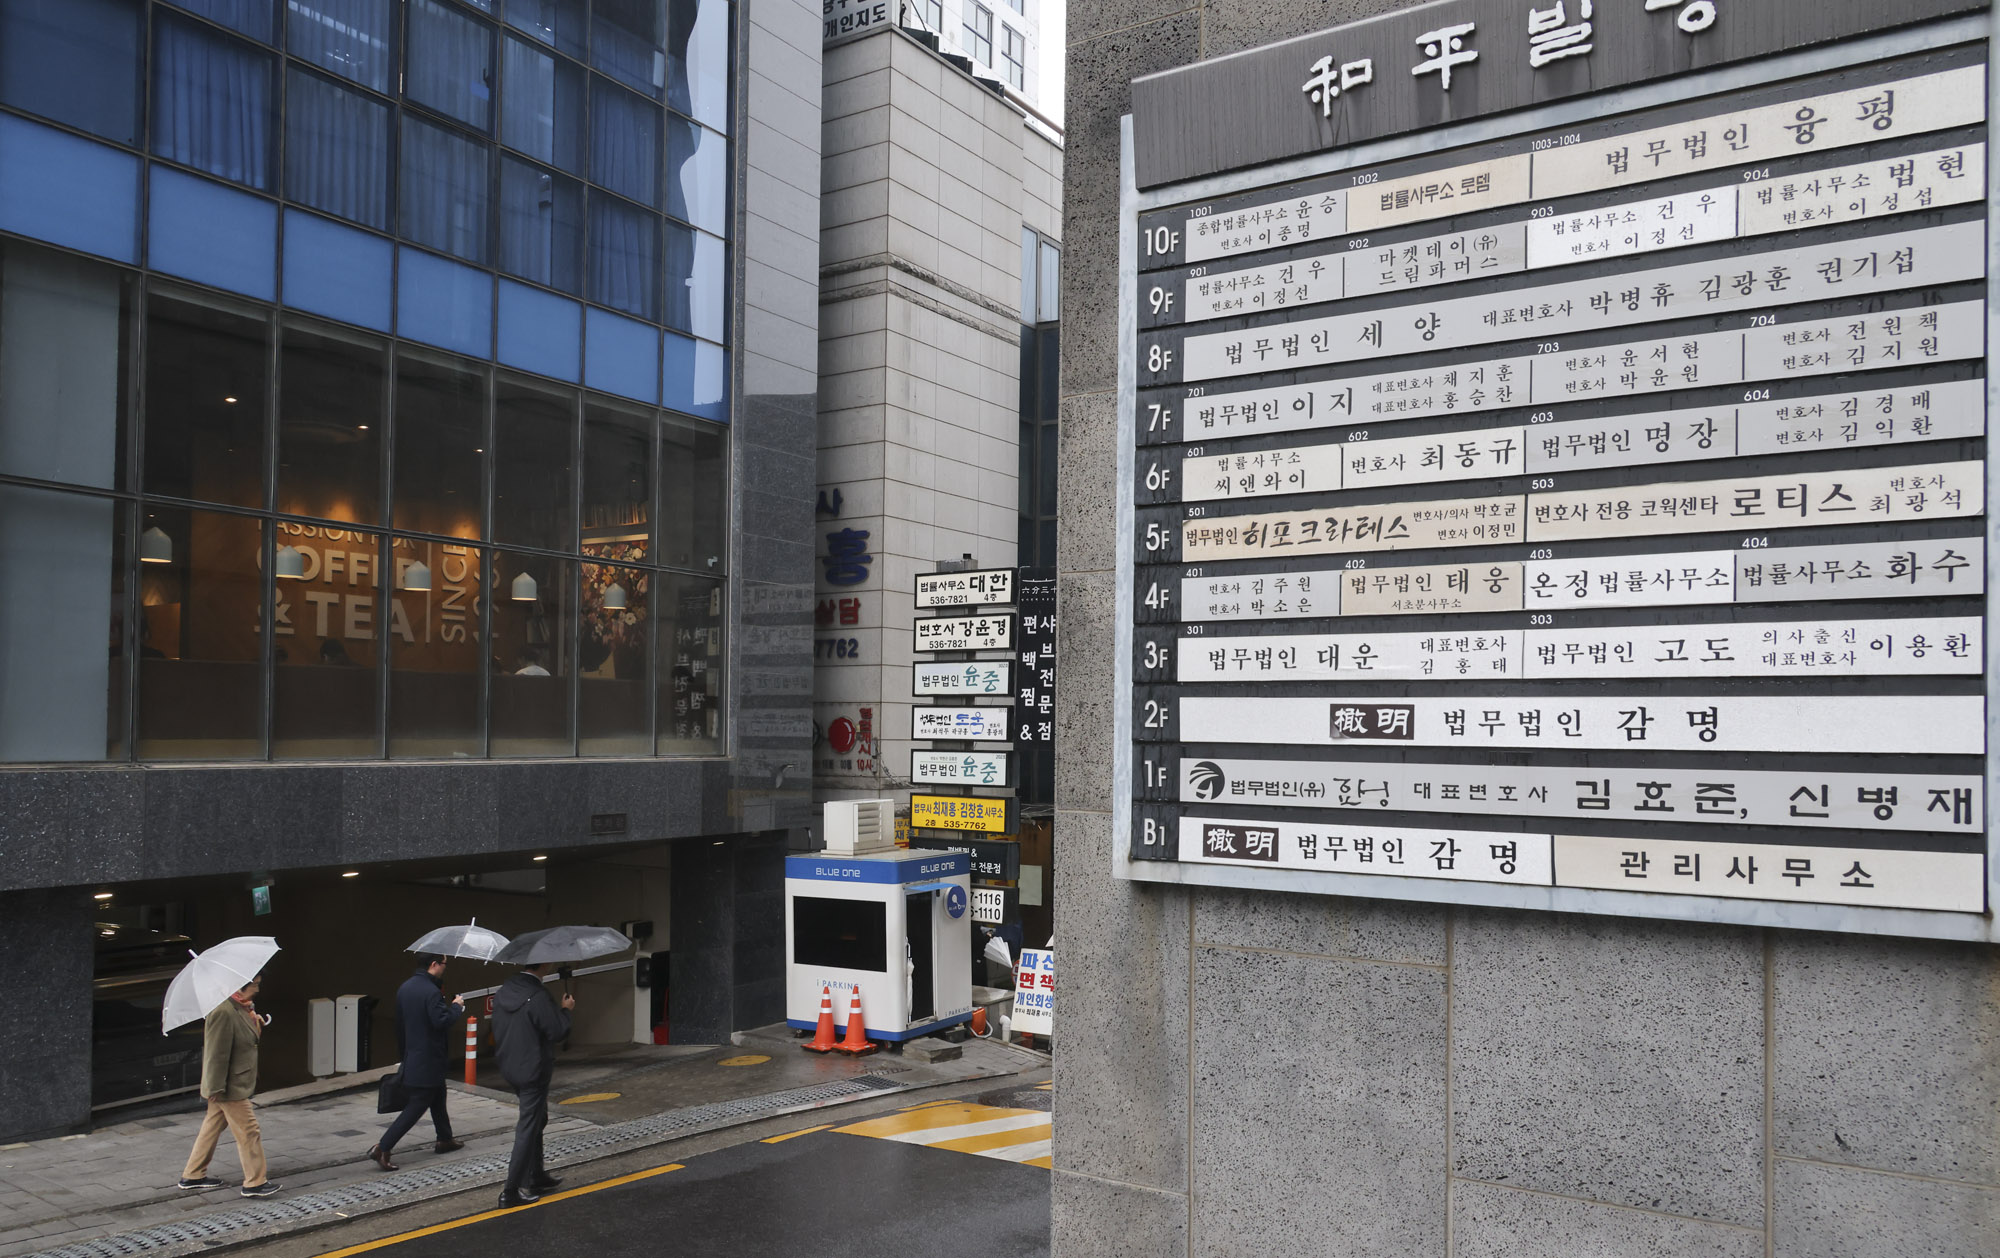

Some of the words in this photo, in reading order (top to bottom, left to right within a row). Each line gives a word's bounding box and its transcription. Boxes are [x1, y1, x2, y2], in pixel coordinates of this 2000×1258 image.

[825, 3, 885, 38] 개인지도
[1606, 124, 1749, 175] 법무법인
[1782, 90, 1895, 145] 융평
[1744, 168, 1769, 182] 904
[1757, 172, 1871, 204] 법률사무소
[1889, 151, 1965, 189] 법현
[1381, 184, 1454, 211] 법률사무소
[1850, 187, 1932, 216] 이성섭
[1190, 206, 1213, 218] 1001
[1196, 206, 1288, 235] 종합법률사무소
[1296, 195, 1337, 218] 윤승
[1531, 206, 1554, 218] 903
[1553, 210, 1637, 235] 법률사무소
[1657, 194, 1716, 220] 건우
[1144, 226, 1179, 256] 10F
[1259, 223, 1310, 245] 이종명
[1349, 239, 1369, 250] 902
[1625, 224, 1694, 249] 이정선
[1380, 235, 1497, 266] 마켓데이(유)
[1199, 274, 1264, 296] 법률사무소
[1280, 261, 1325, 283] 건우
[1380, 256, 1498, 286] 드림파머스
[1149, 288, 1173, 314] 9F
[1226, 331, 1330, 364] 법무법인
[1357, 313, 1441, 349] 세양
[1483, 299, 1573, 327] 대표변호사
[1590, 283, 1674, 312] 박병휴
[1699, 265, 1791, 305] 김광훈
[1817, 247, 1914, 284] 권기섭
[1252, 287, 1308, 308] 이정선
[1750, 315, 1776, 326] 704
[1848, 312, 1938, 340] 전원책
[1148, 345, 1172, 372] 8F
[1537, 342, 1559, 353] 703
[1620, 342, 1699, 367] 윤서현
[1847, 336, 1939, 365] 김지원
[1373, 377, 1434, 393] 대표변호사
[1444, 364, 1513, 387] 채지훈
[1620, 365, 1698, 390] 박윤원
[1200, 400, 1280, 428] 법무법인
[1293, 388, 1353, 419] 이지
[1373, 397, 1434, 414] 대표변호사
[1443, 386, 1512, 410] 홍승찬
[1743, 389, 1770, 401] 604
[1839, 391, 1931, 417] 김경배
[1148, 405, 1171, 431] 7F
[1531, 411, 1554, 424] 603
[1839, 417, 1932, 442] 김익환
[1542, 429, 1630, 458] 법무법인
[1646, 418, 1718, 453] 명장
[1218, 452, 1301, 471] 법률사무소
[1420, 439, 1516, 470] 최동규
[1146, 464, 1170, 490] 6F
[1215, 470, 1306, 493] 씨앤와이
[1532, 478, 1554, 489] 503
[1413, 505, 1469, 521] 변호사/의사
[1474, 503, 1516, 519] 박호균
[1596, 500, 1632, 520] 전용
[1639, 496, 1718, 518] 코웍센타
[1730, 484, 1856, 517] 로티스
[1869, 490, 1962, 514] 최광석
[1146, 524, 1169, 550] 5F
[1186, 528, 1239, 547] 법무법인
[1243, 515, 1410, 548] 히포크라테스
[1473, 522, 1515, 539] 이정민
[1742, 537, 1768, 548] 404
[823, 528, 873, 585] 홍
[1744, 560, 1872, 586] 법률사무소
[1885, 549, 1970, 584] 화수
[441, 538, 467, 644] SINCE
[921, 581, 965, 592] 법률사무소
[970, 574, 1008, 592] 대한
[1251, 577, 1311, 593] 김주원
[1350, 574, 1432, 595] 법무법인
[1447, 567, 1509, 594] 태웅
[1530, 571, 1589, 598] 온정
[1599, 568, 1730, 594] 법률사무소
[930, 595, 968, 604] 536-7821
[984, 594, 997, 602] 4층
[1145, 582, 1169, 609] 4F
[1251, 599, 1311, 615] 박소은
[1392, 599, 1461, 610] 서초분사무소
[306, 591, 415, 642] TEA
[920, 624, 955, 636] 변호사
[959, 619, 1005, 636] 강윤경
[1187, 625, 1203, 634] 301
[1530, 614, 1553, 624] 303
[929, 640, 967, 648] 536-7821
[1420, 637, 1507, 654] 대표변호사
[1762, 628, 1856, 644] 의사출신
[1869, 632, 1970, 658] 이용환
[1021, 615, 1037, 707] 편백찜
[1145, 641, 1167, 667] 3F
[1209, 647, 1297, 671] 법무법인
[1317, 643, 1378, 671] 대운
[1538, 642, 1634, 664] 법무법인
[1654, 638, 1735, 663] 고도
[1762, 651, 1856, 667] 대표변호사
[922, 675, 959, 687] 법무법인
[963, 665, 999, 692] 윤중
[1420, 657, 1507, 674] 김홍태
[1145, 700, 1168, 727] 2F
[1443, 709, 1582, 737] 법무법인
[1617, 706, 1719, 743] 감명
[1020, 724, 1032, 740] &
[920, 764, 957, 776] 법무법인
[961, 756, 997, 783] 윤중
[1146, 761, 1166, 788] 1F
[914, 804, 932, 813] 법무사
[985, 807, 1003, 818] 사무소
[1231, 779, 1326, 798] 법무법인(유)
[1414, 782, 1547, 803] 대표변호사
[1575, 779, 1748, 819] 김효준,
[1789, 784, 1972, 825] 신병재
[944, 821, 985, 829] 535-7762
[1144, 819, 1165, 846] B1
[1297, 833, 1405, 865] 법무법인
[1429, 838, 1519, 875] 감명
[979, 863, 1000, 874] 전문점
[1620, 851, 1874, 888] 관리사무소
[1016, 992, 1053, 1009] 개인회생
